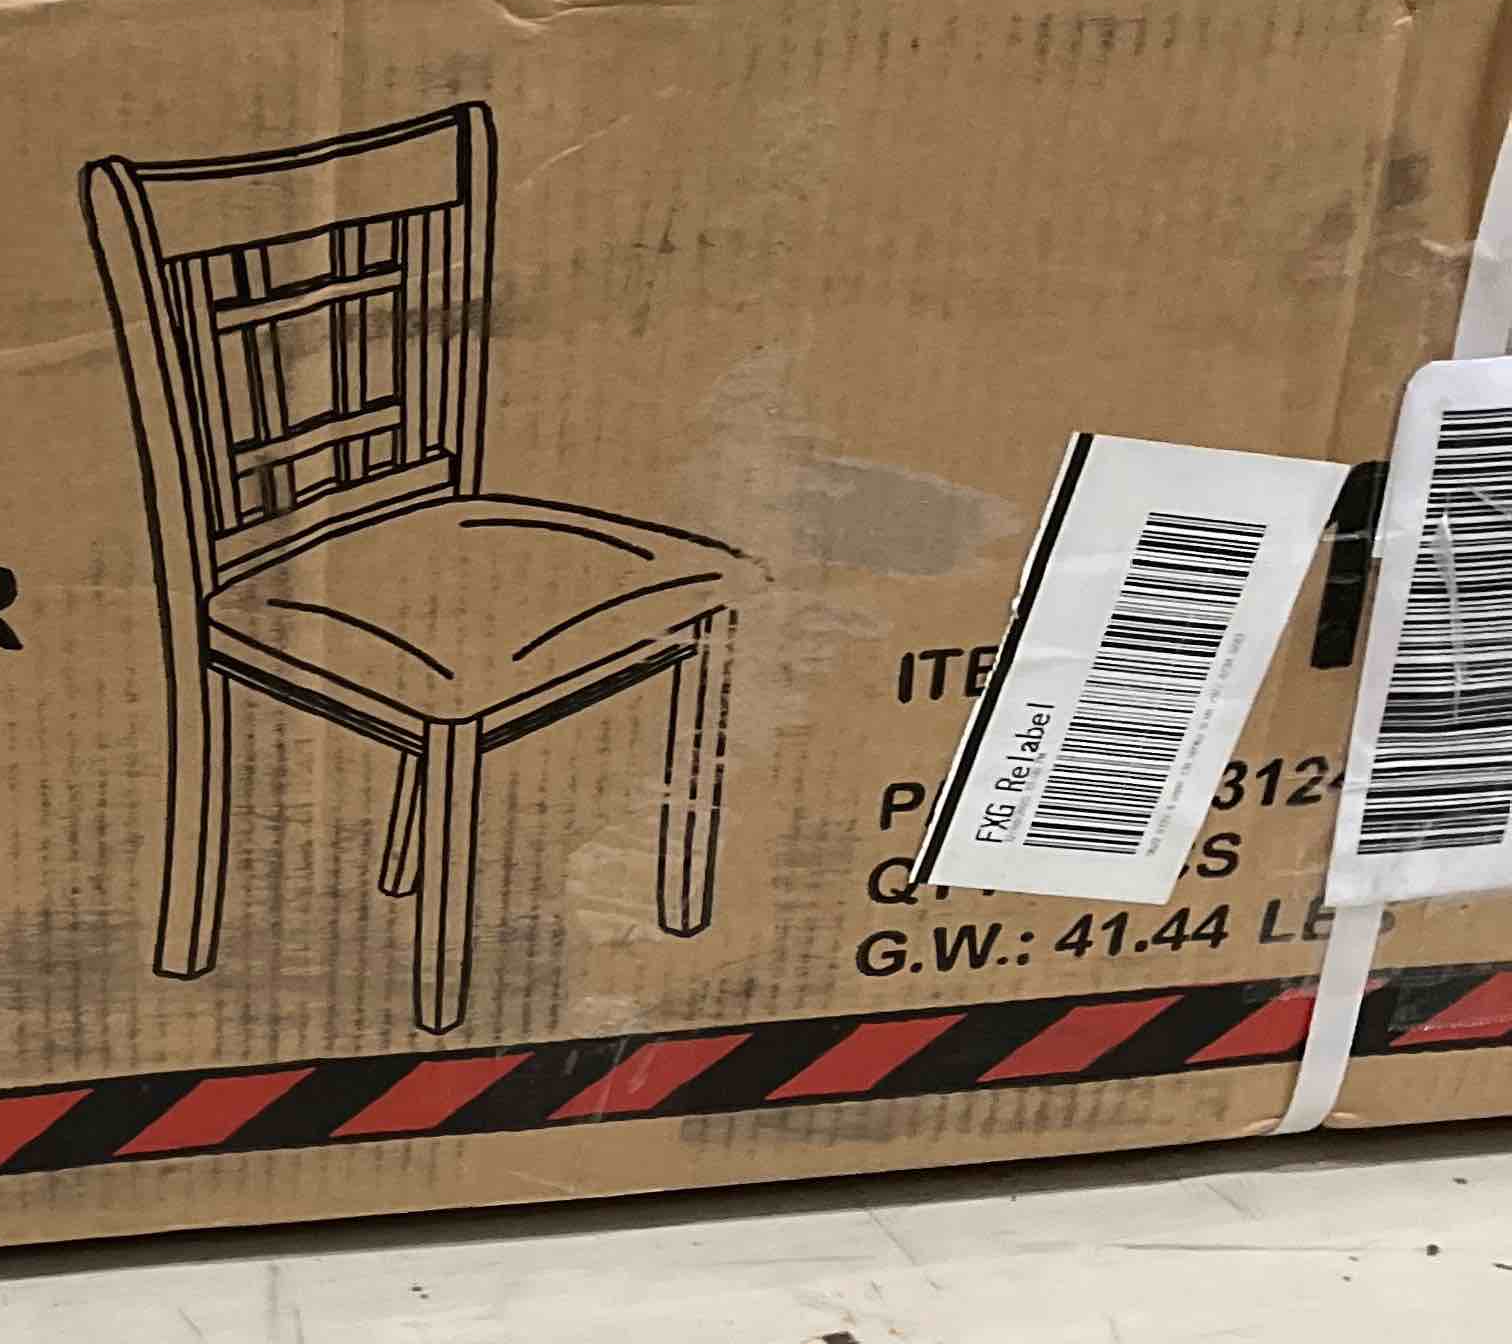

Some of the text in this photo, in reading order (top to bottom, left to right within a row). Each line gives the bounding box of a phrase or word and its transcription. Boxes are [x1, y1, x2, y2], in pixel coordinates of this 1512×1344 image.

[897, 645, 999, 704] ITE
[995, 702, 1056, 793] Relabel
[975, 802, 1016, 844] FXG
[1054, 903, 1230, 958] 41.44
